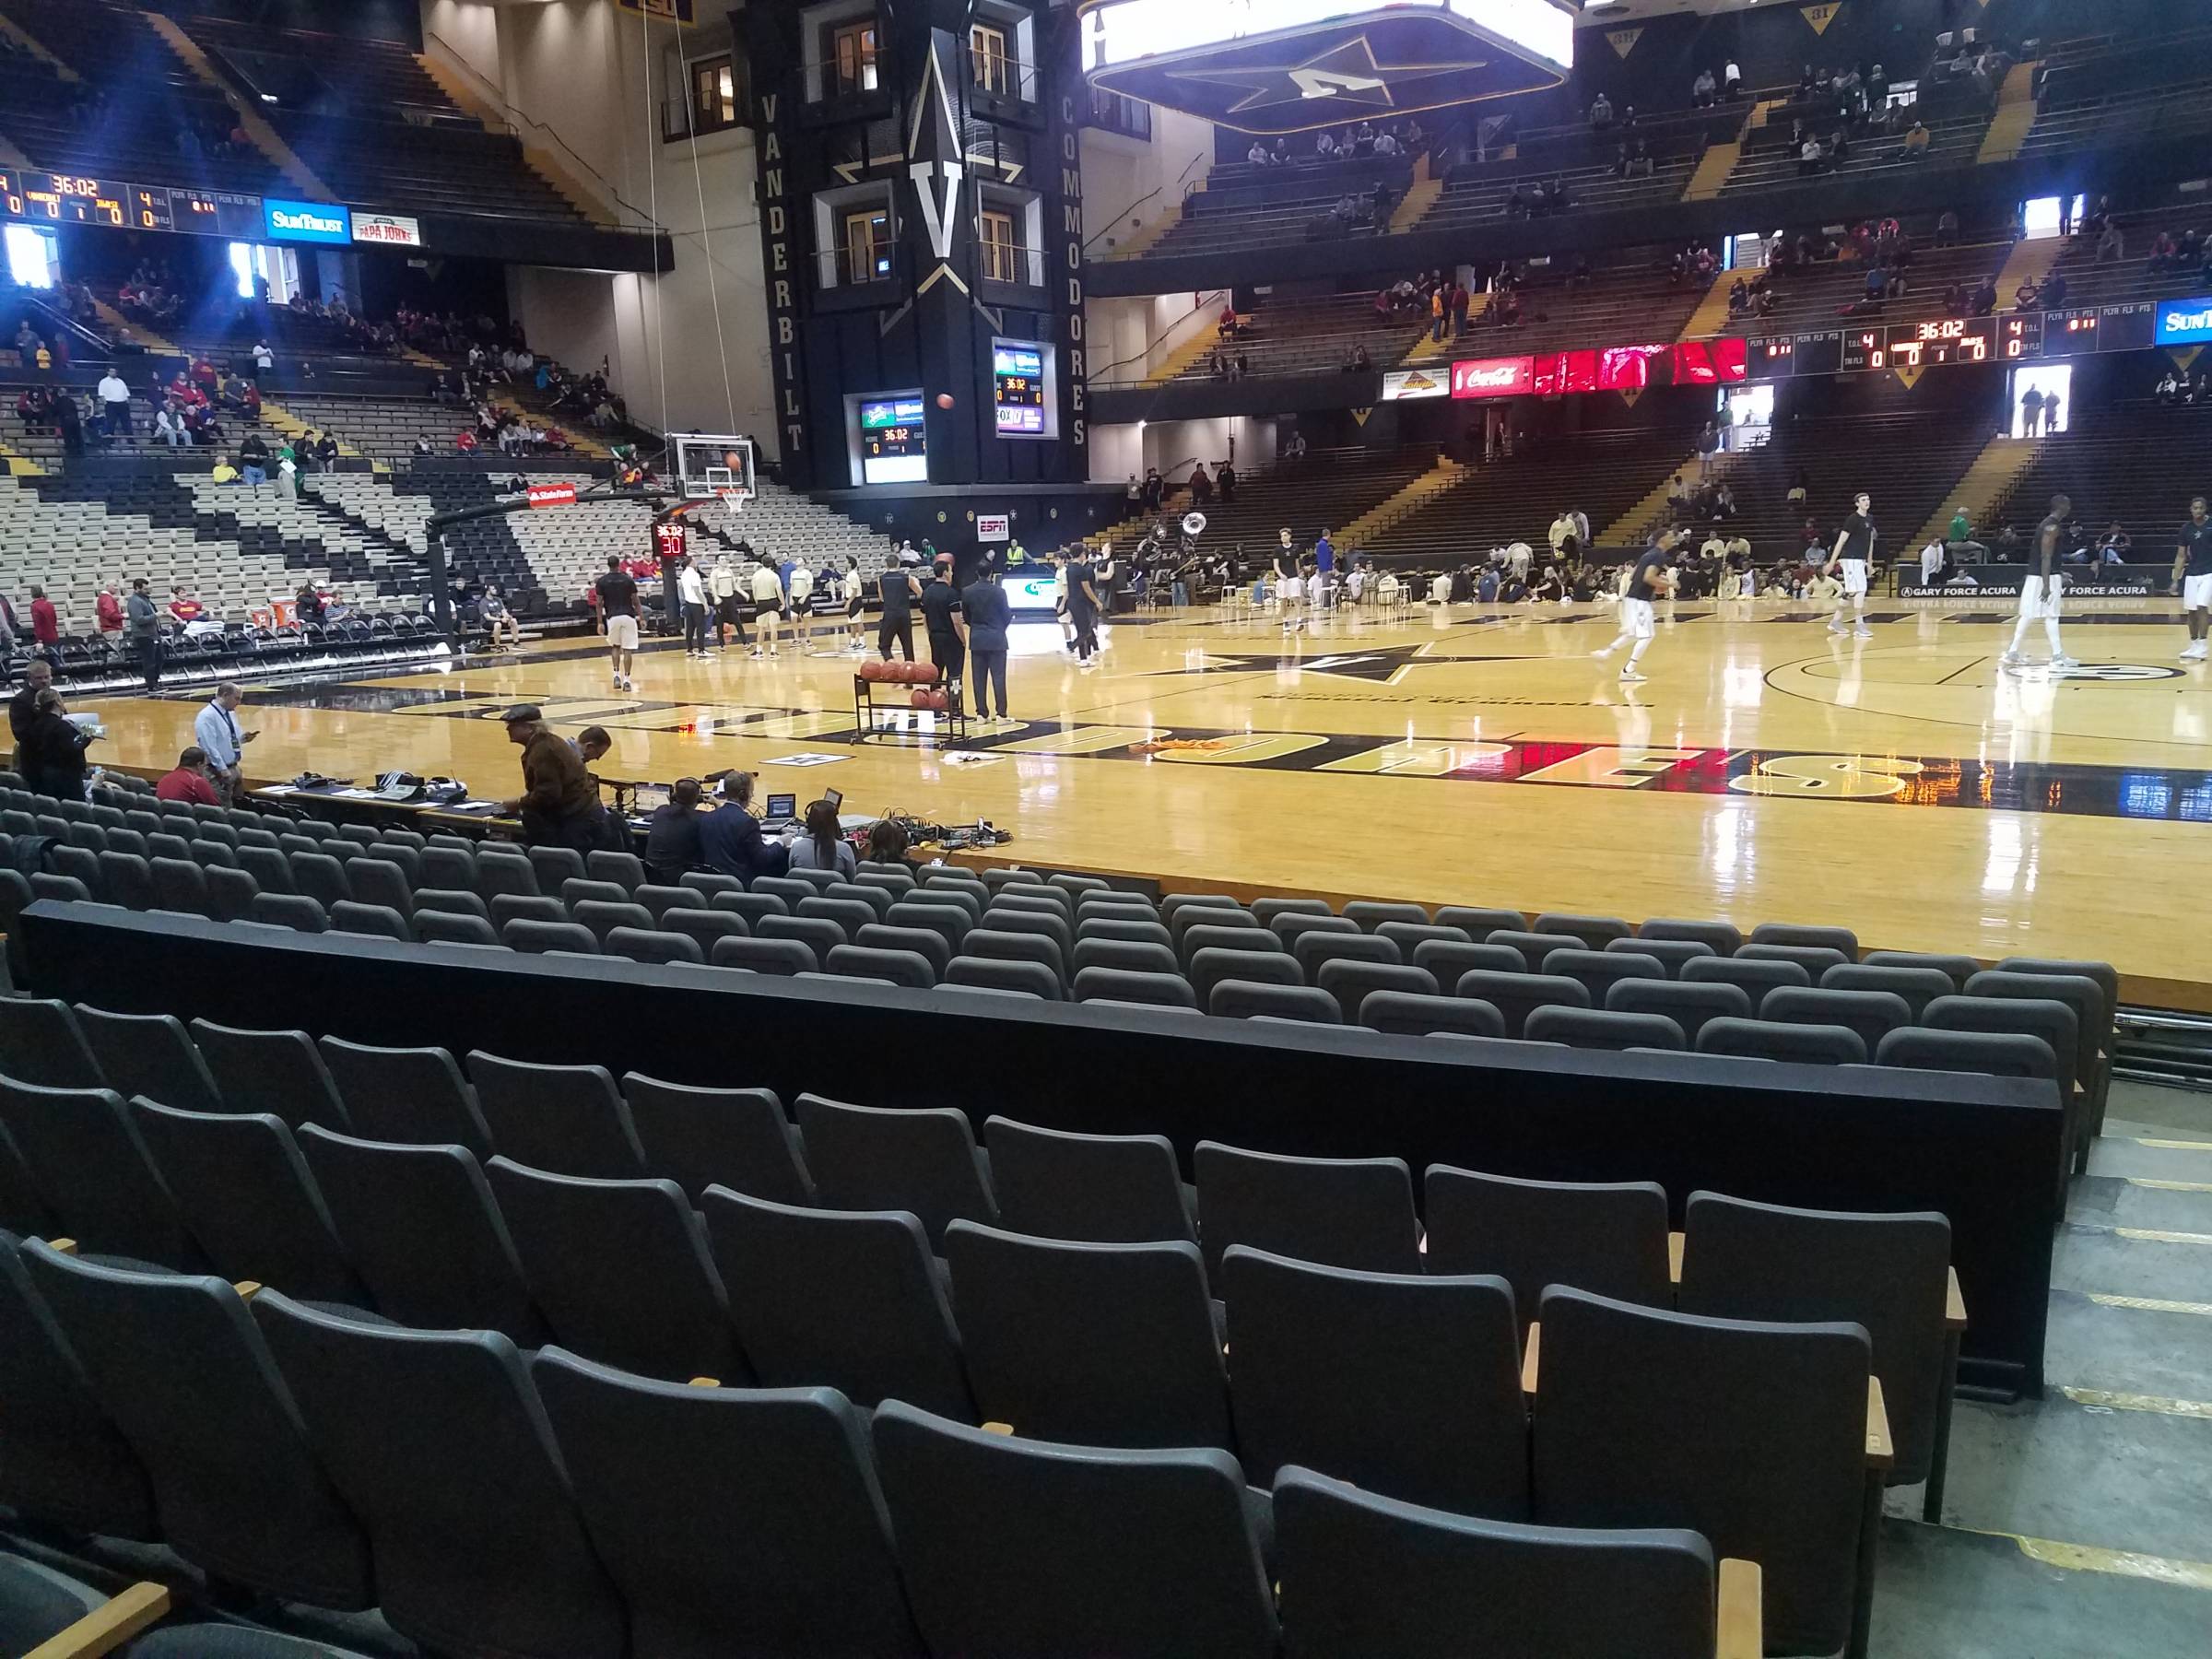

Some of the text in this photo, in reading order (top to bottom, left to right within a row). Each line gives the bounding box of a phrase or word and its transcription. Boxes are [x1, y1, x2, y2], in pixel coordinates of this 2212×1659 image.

[53, 175, 98, 197] 36:02
[9, 196, 21, 214] 0
[139, 192, 152, 207] 4
[48, 202, 59, 218] 0
[111, 208, 123, 225] 0
[909, 159, 963, 258] V
[142, 210, 155, 227] 0
[761, 93, 803, 451] VANDERBILT
[1062, 95, 1085, 445] COMMODORES
[1918, 320, 1965, 340] 36:02
[2009, 321, 2023, 335] 4
[1863, 334, 1874, 348] 4
[2008, 339, 2021, 357] 0
[1871, 350, 1883, 368] 0
[1908, 349, 1920, 366] 0
[1973, 342, 1985, 360] 0
[885, 428, 908, 441] 36:02
[872, 442, 879, 454] 0
[980, 520, 1006, 533] ESPN
[662, 536, 681, 554] 30
[1912, 586, 2017, 597] GARY FORCE ACURA
[2069, 587, 2106, 595] FORCE
[2108, 585, 2147, 595] ACURA
